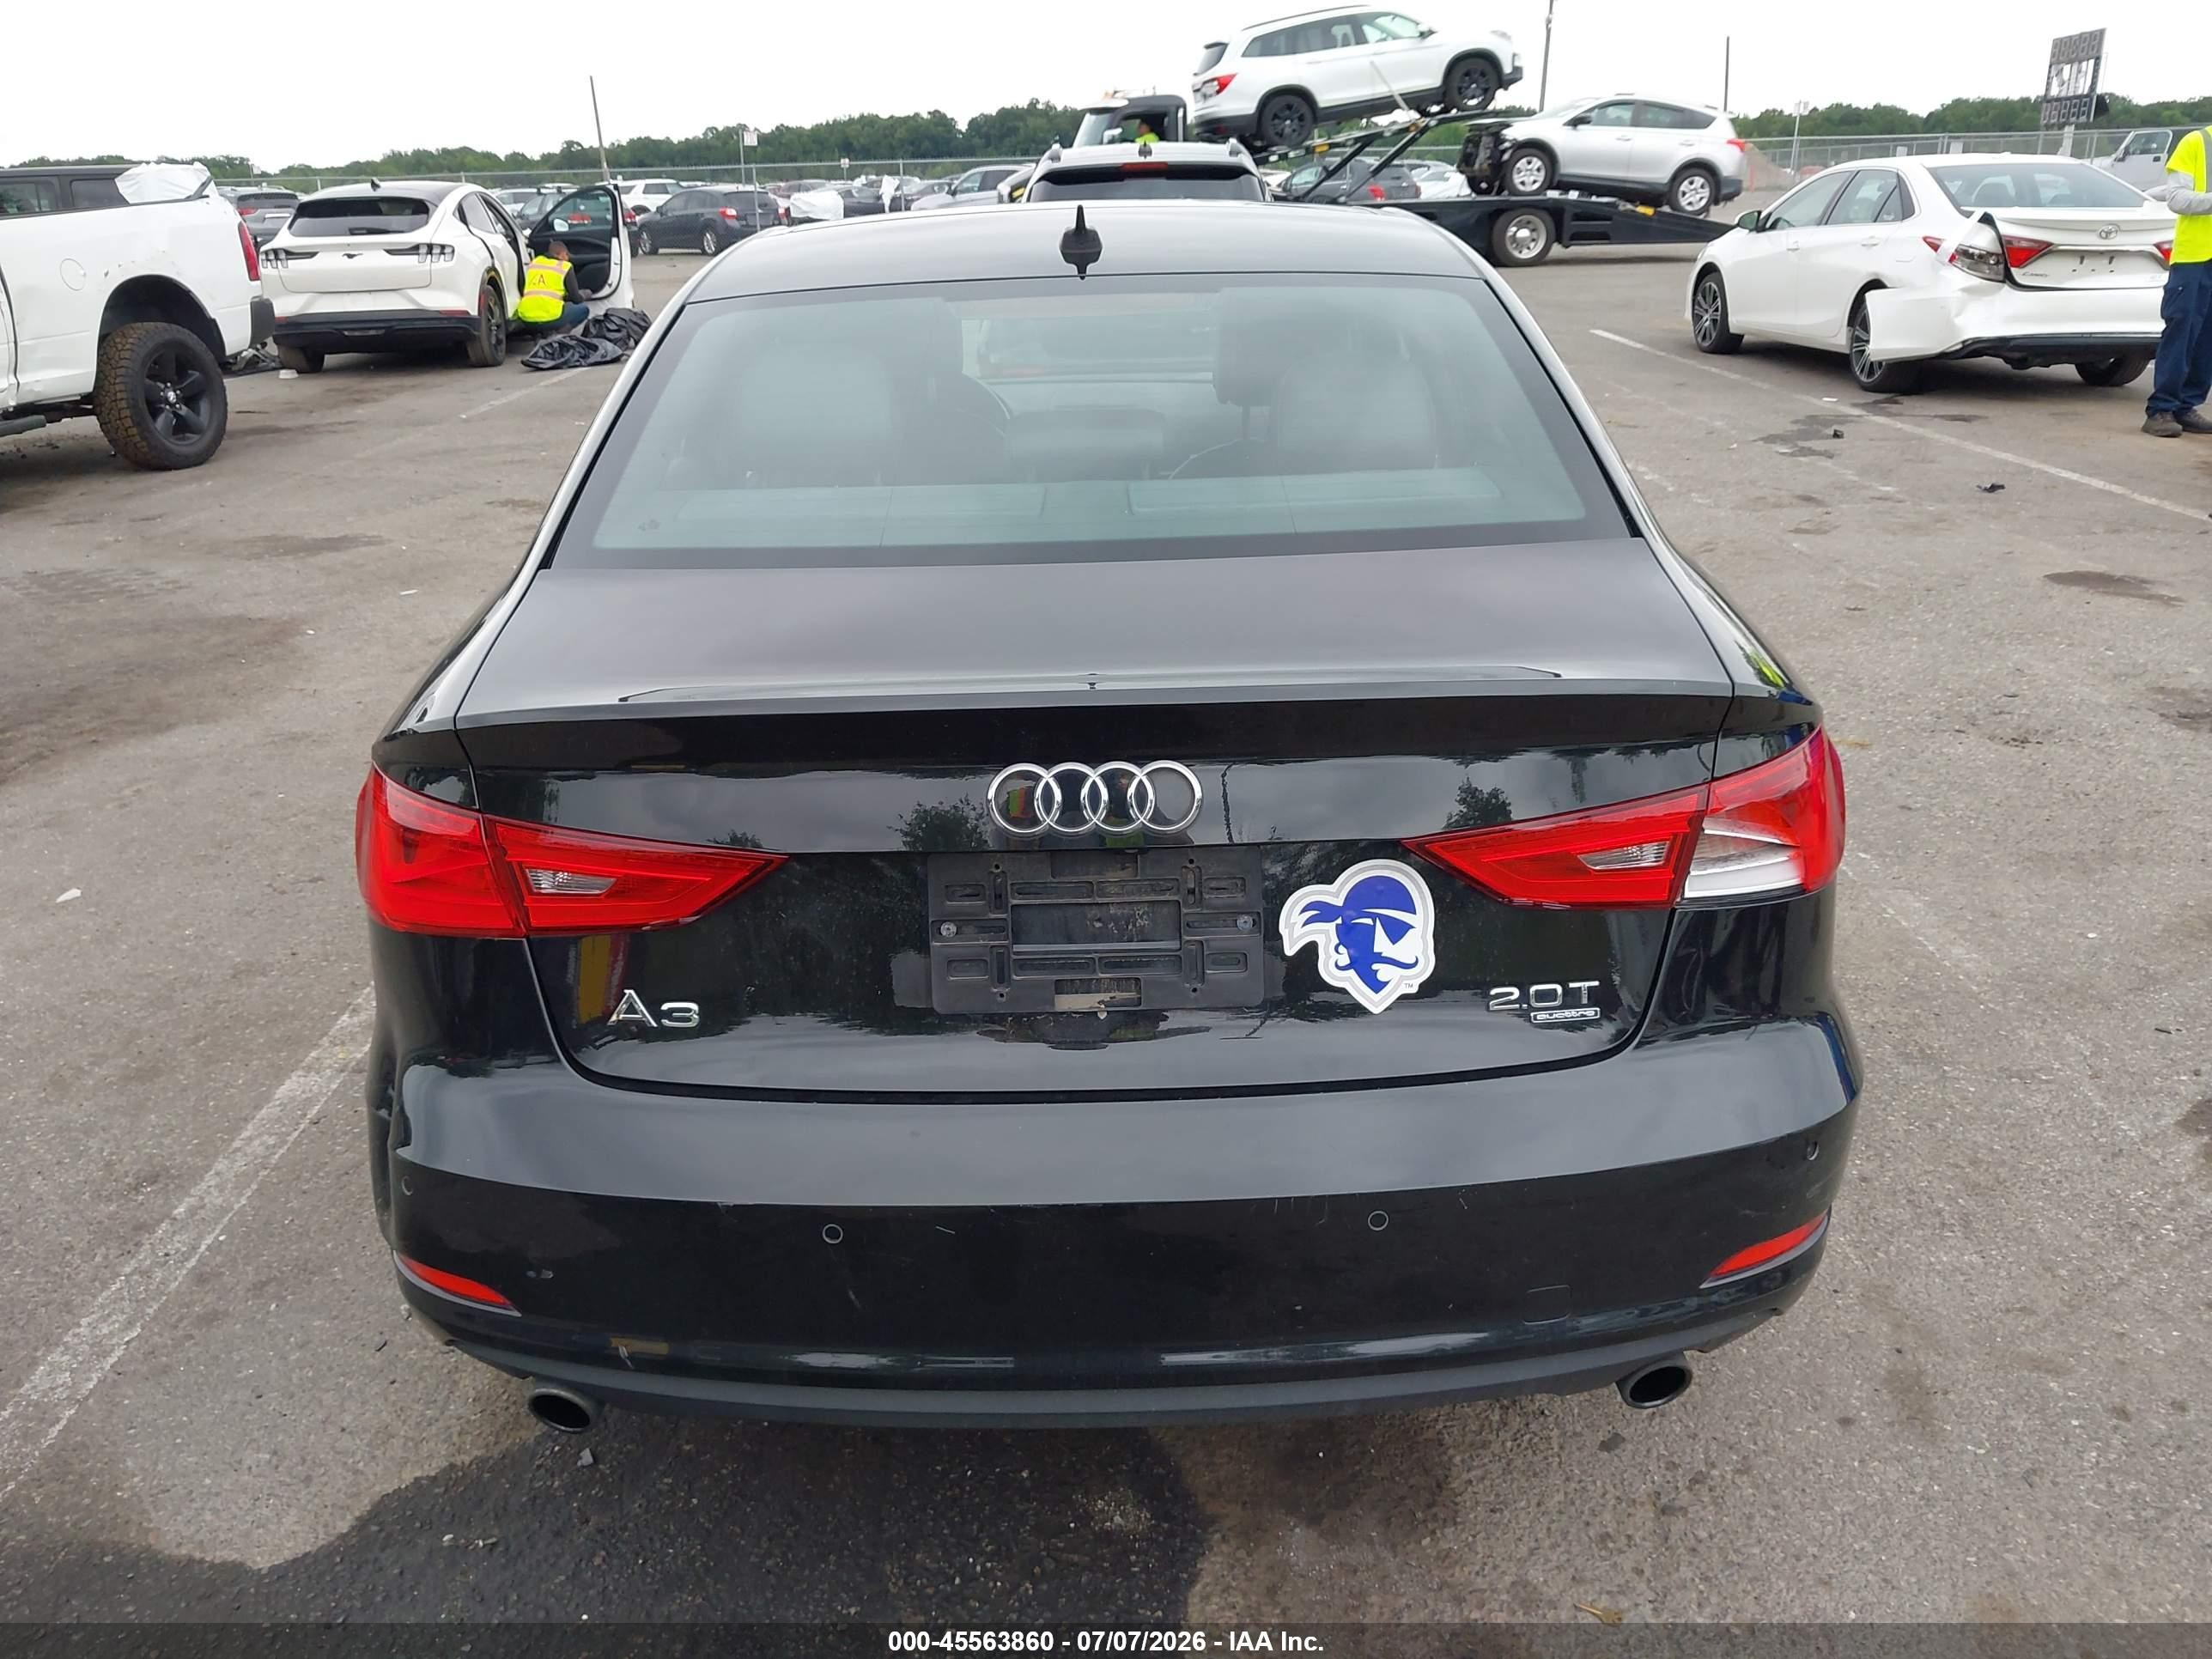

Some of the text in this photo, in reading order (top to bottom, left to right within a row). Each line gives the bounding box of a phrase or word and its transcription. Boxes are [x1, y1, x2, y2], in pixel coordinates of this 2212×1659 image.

[606, 988, 700, 1028] A3
[1489, 981, 1600, 1011] 2.0T
[1536, 1010, 1595, 1020] quattro
